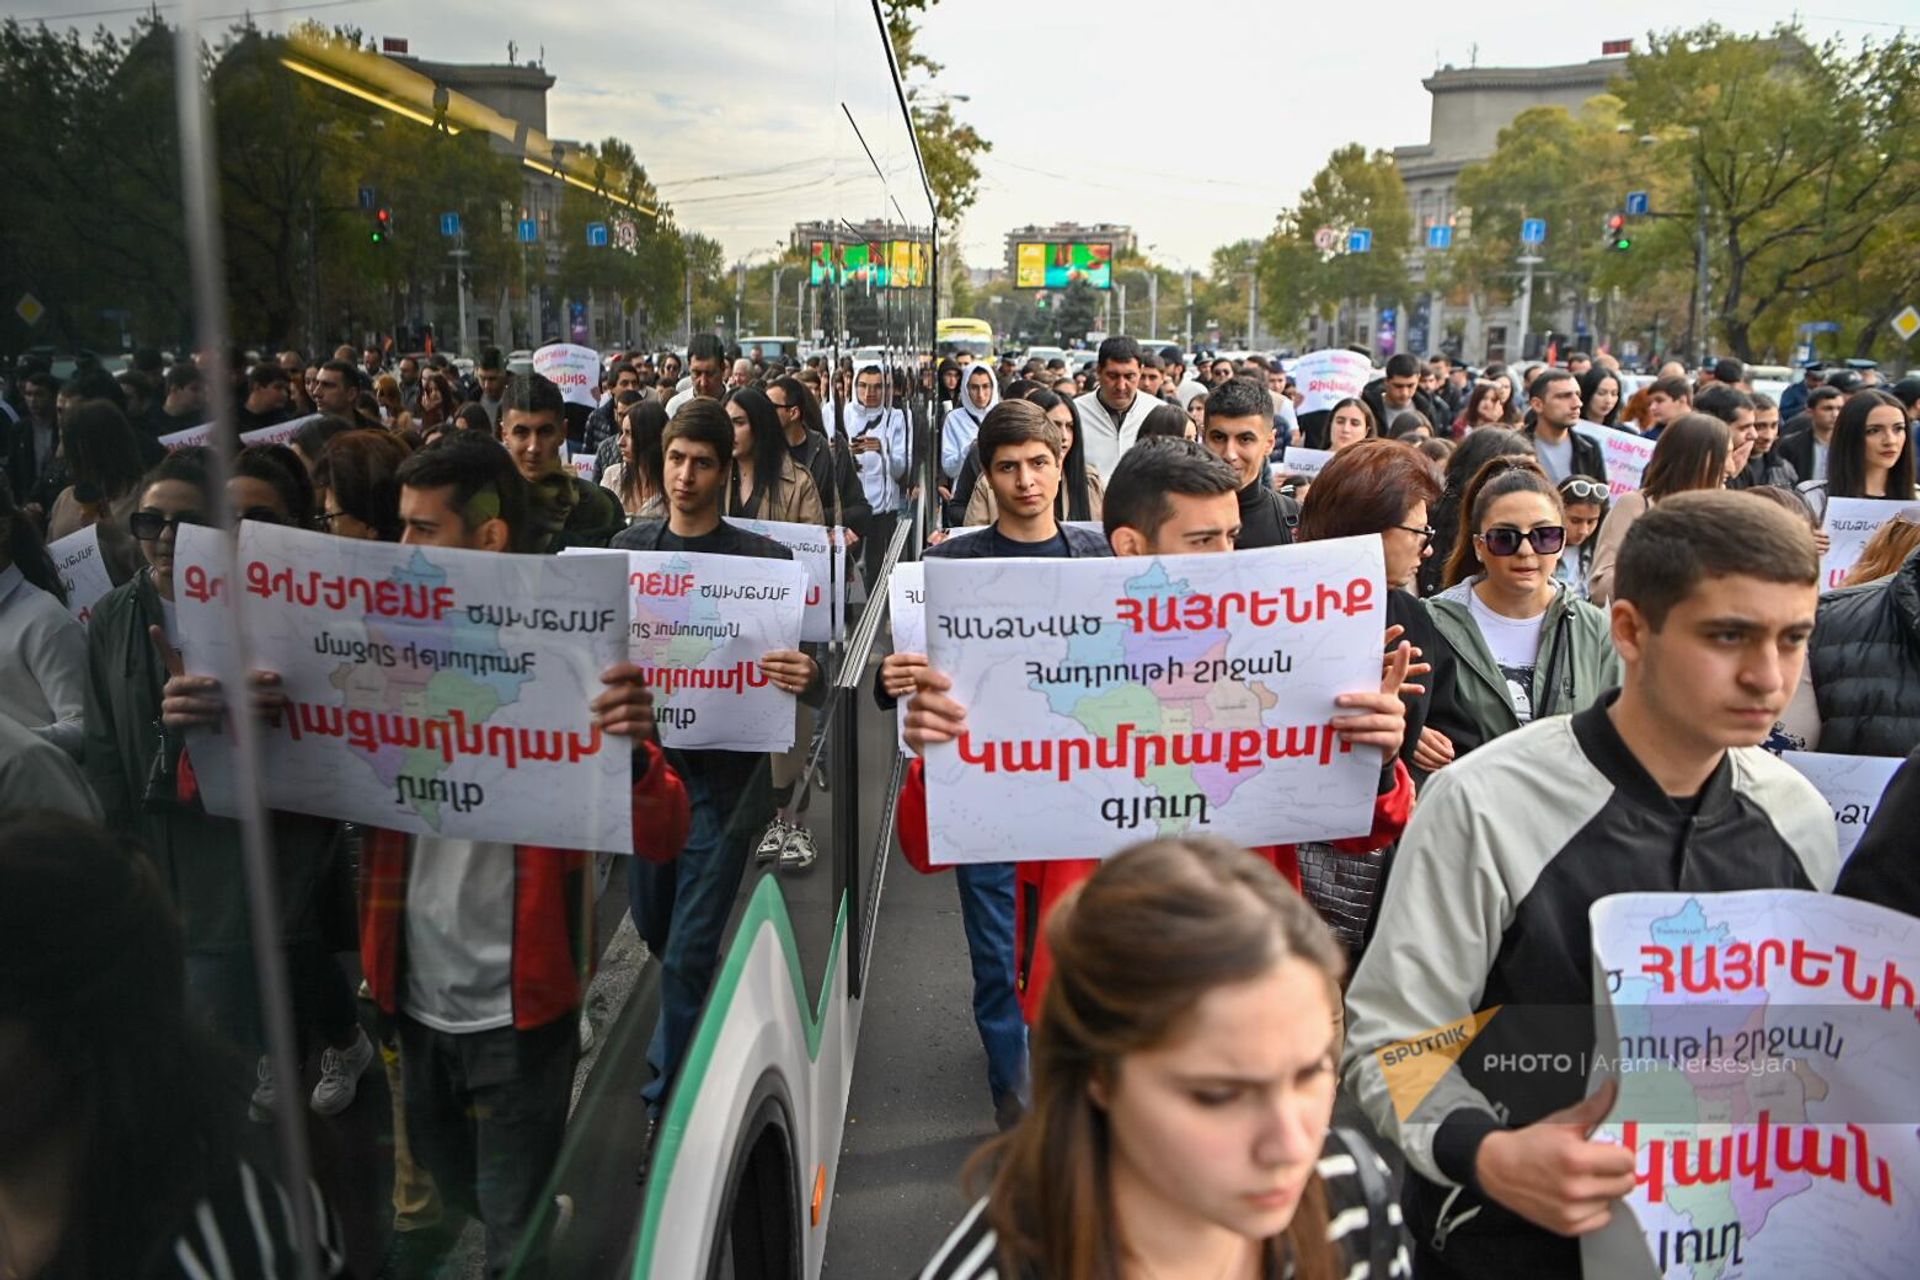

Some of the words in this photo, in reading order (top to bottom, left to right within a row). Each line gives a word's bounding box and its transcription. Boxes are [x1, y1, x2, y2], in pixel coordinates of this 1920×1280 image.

[937, 613, 1103, 640] ՀԱՆՁՆՎԱԾ
[1116, 577, 1375, 634] ՀԱՅՐԵՆԻՔ
[1025, 655, 1185, 690] Հադրութի
[1193, 649, 1293, 684] շրջան
[1100, 791, 1211, 829] գյուղ
[1640, 938, 1920, 1024] ՀԱՅՐԵՆԻ
[1734, 1023, 1844, 1061] շրջան
